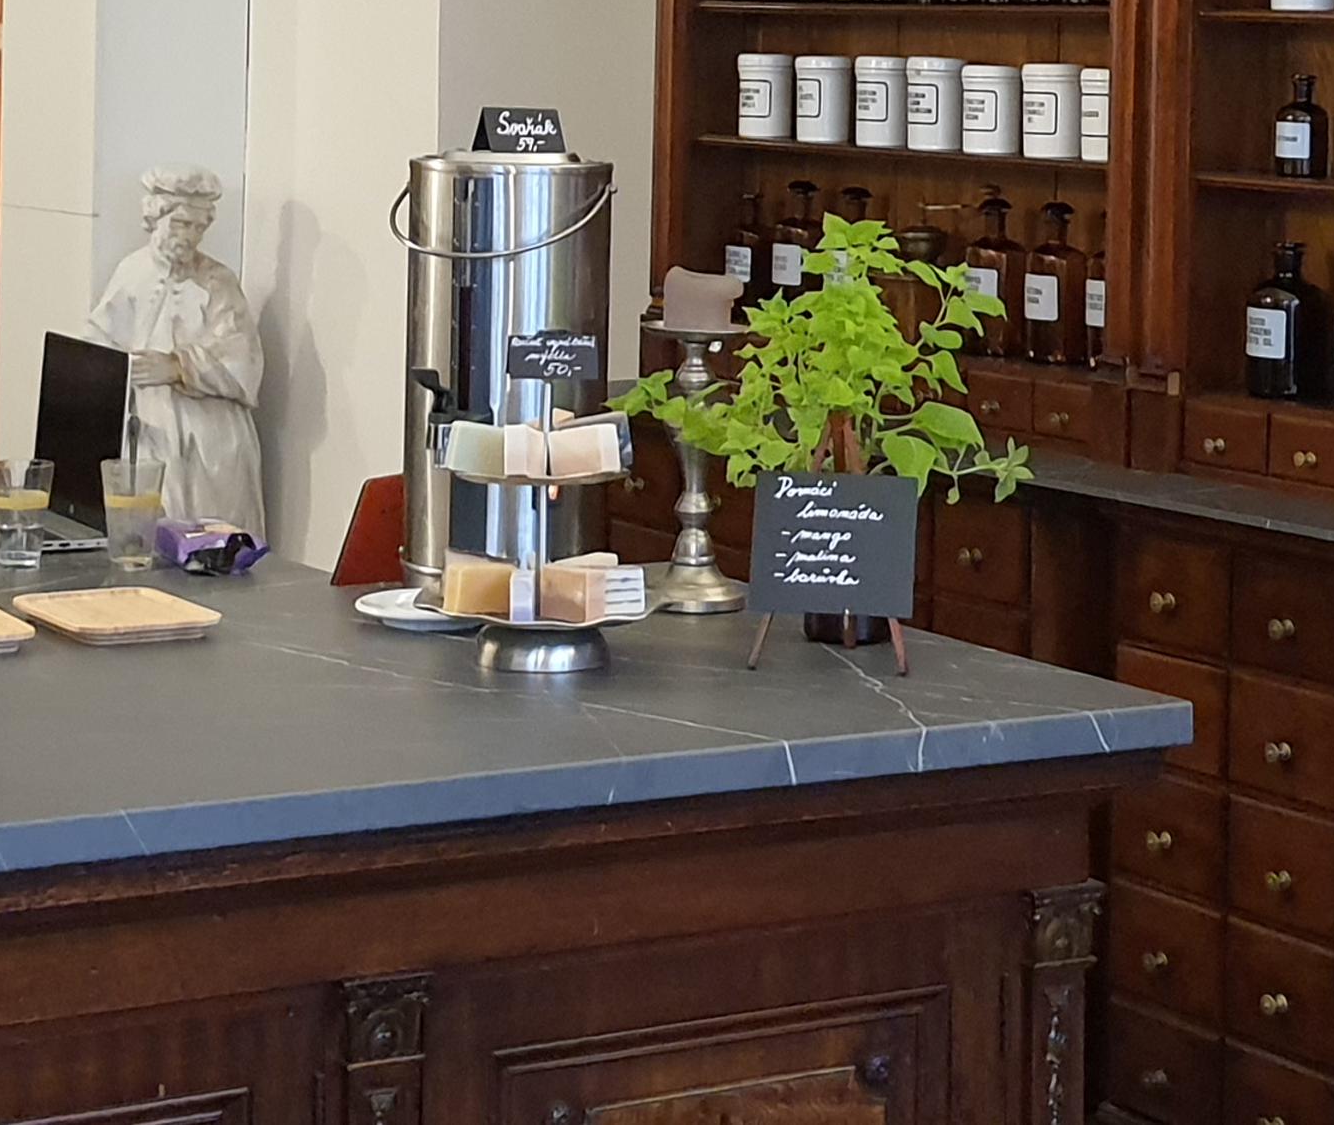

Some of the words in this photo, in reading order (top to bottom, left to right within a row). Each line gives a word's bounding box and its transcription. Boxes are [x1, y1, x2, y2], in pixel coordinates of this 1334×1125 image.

[543, 362, 582, 377] 50,-
[796, 500, 884, 521] limonáda
[791, 529, 852, 551] mango
[786, 549, 856, 567] malina
[783, 568, 860, 585] borůvka
